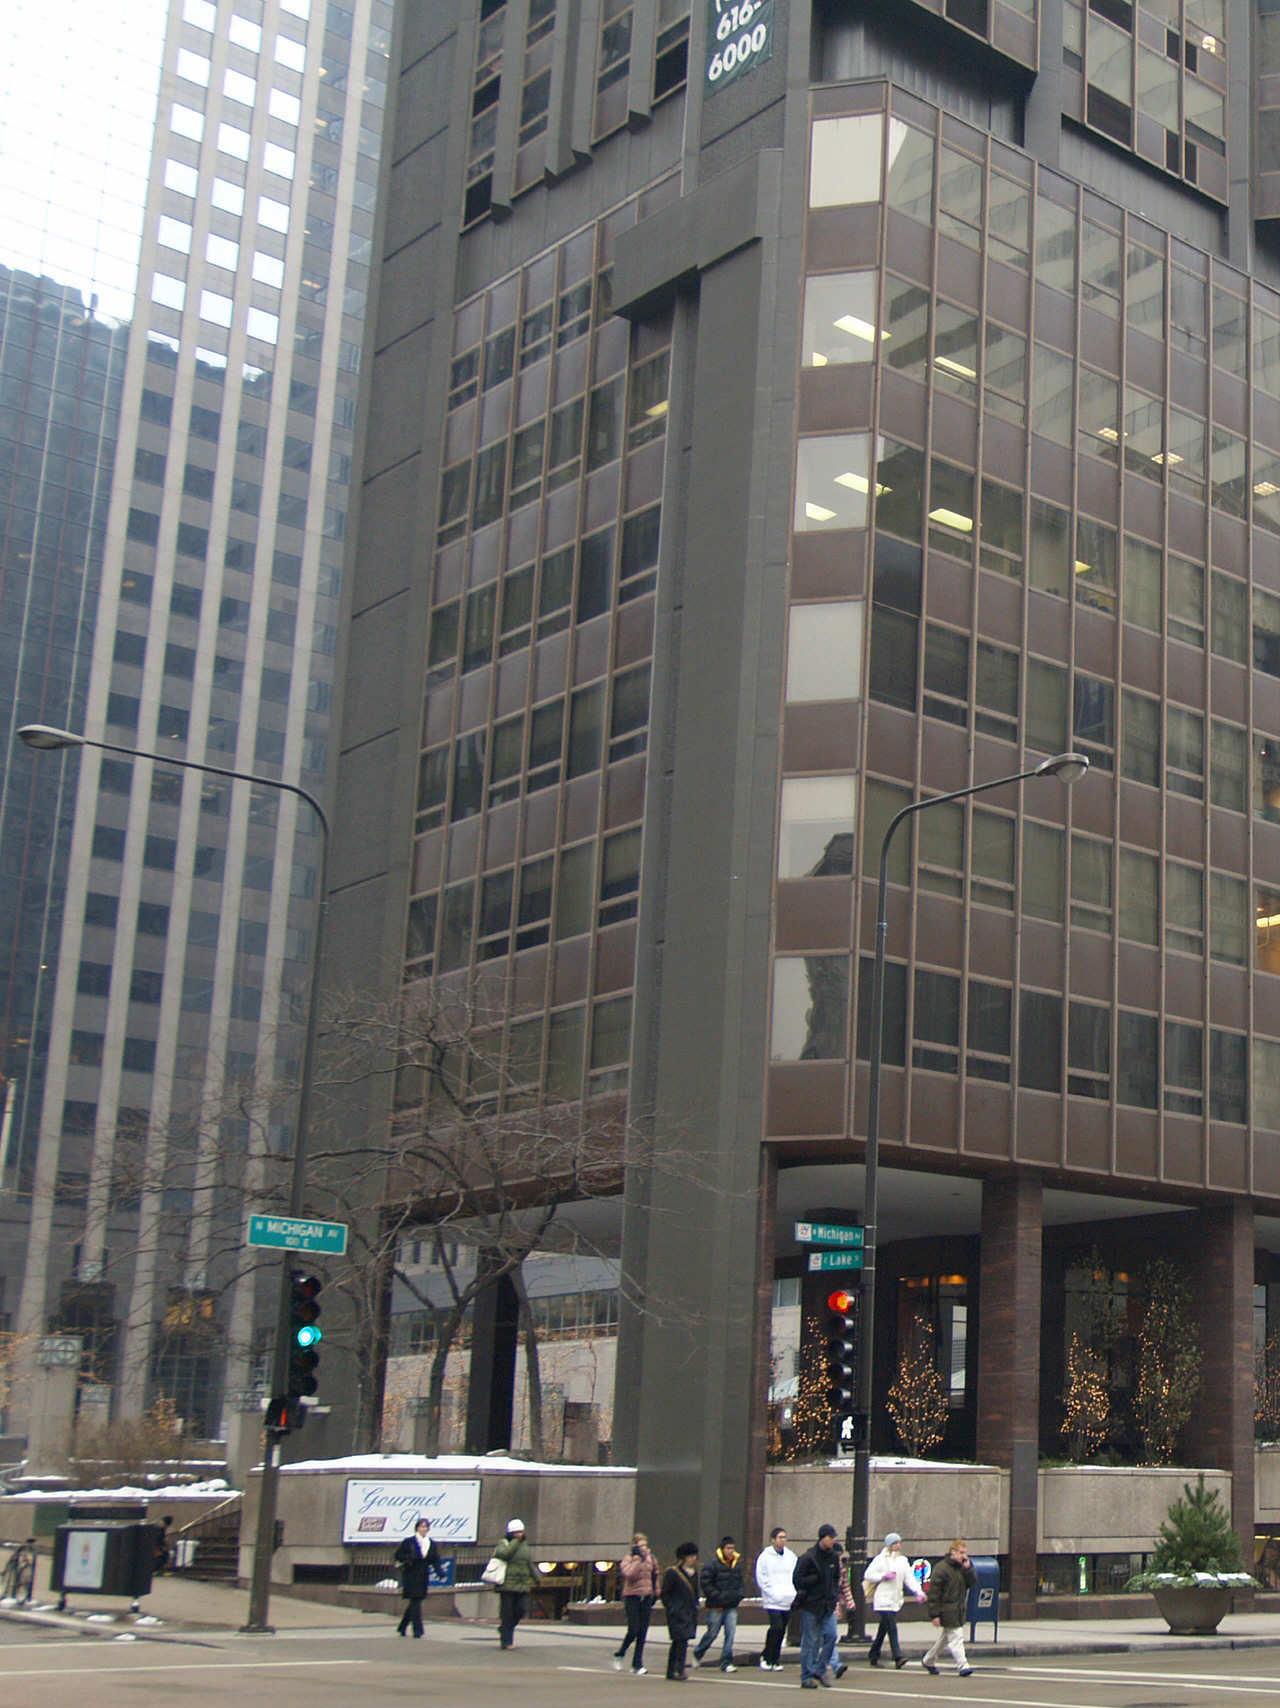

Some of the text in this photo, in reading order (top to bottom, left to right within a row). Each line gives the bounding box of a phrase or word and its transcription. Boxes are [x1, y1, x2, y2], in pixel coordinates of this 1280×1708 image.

[708, 23, 766, 81] 6000
[267, 1220, 324, 1239] MICHIGAN
[818, 1227, 853, 1244] Michigan
[830, 1254, 852, 1266] Lake
[359, 1487, 447, 1513] Gourmet
[393, 1509, 469, 1535] Pntry
